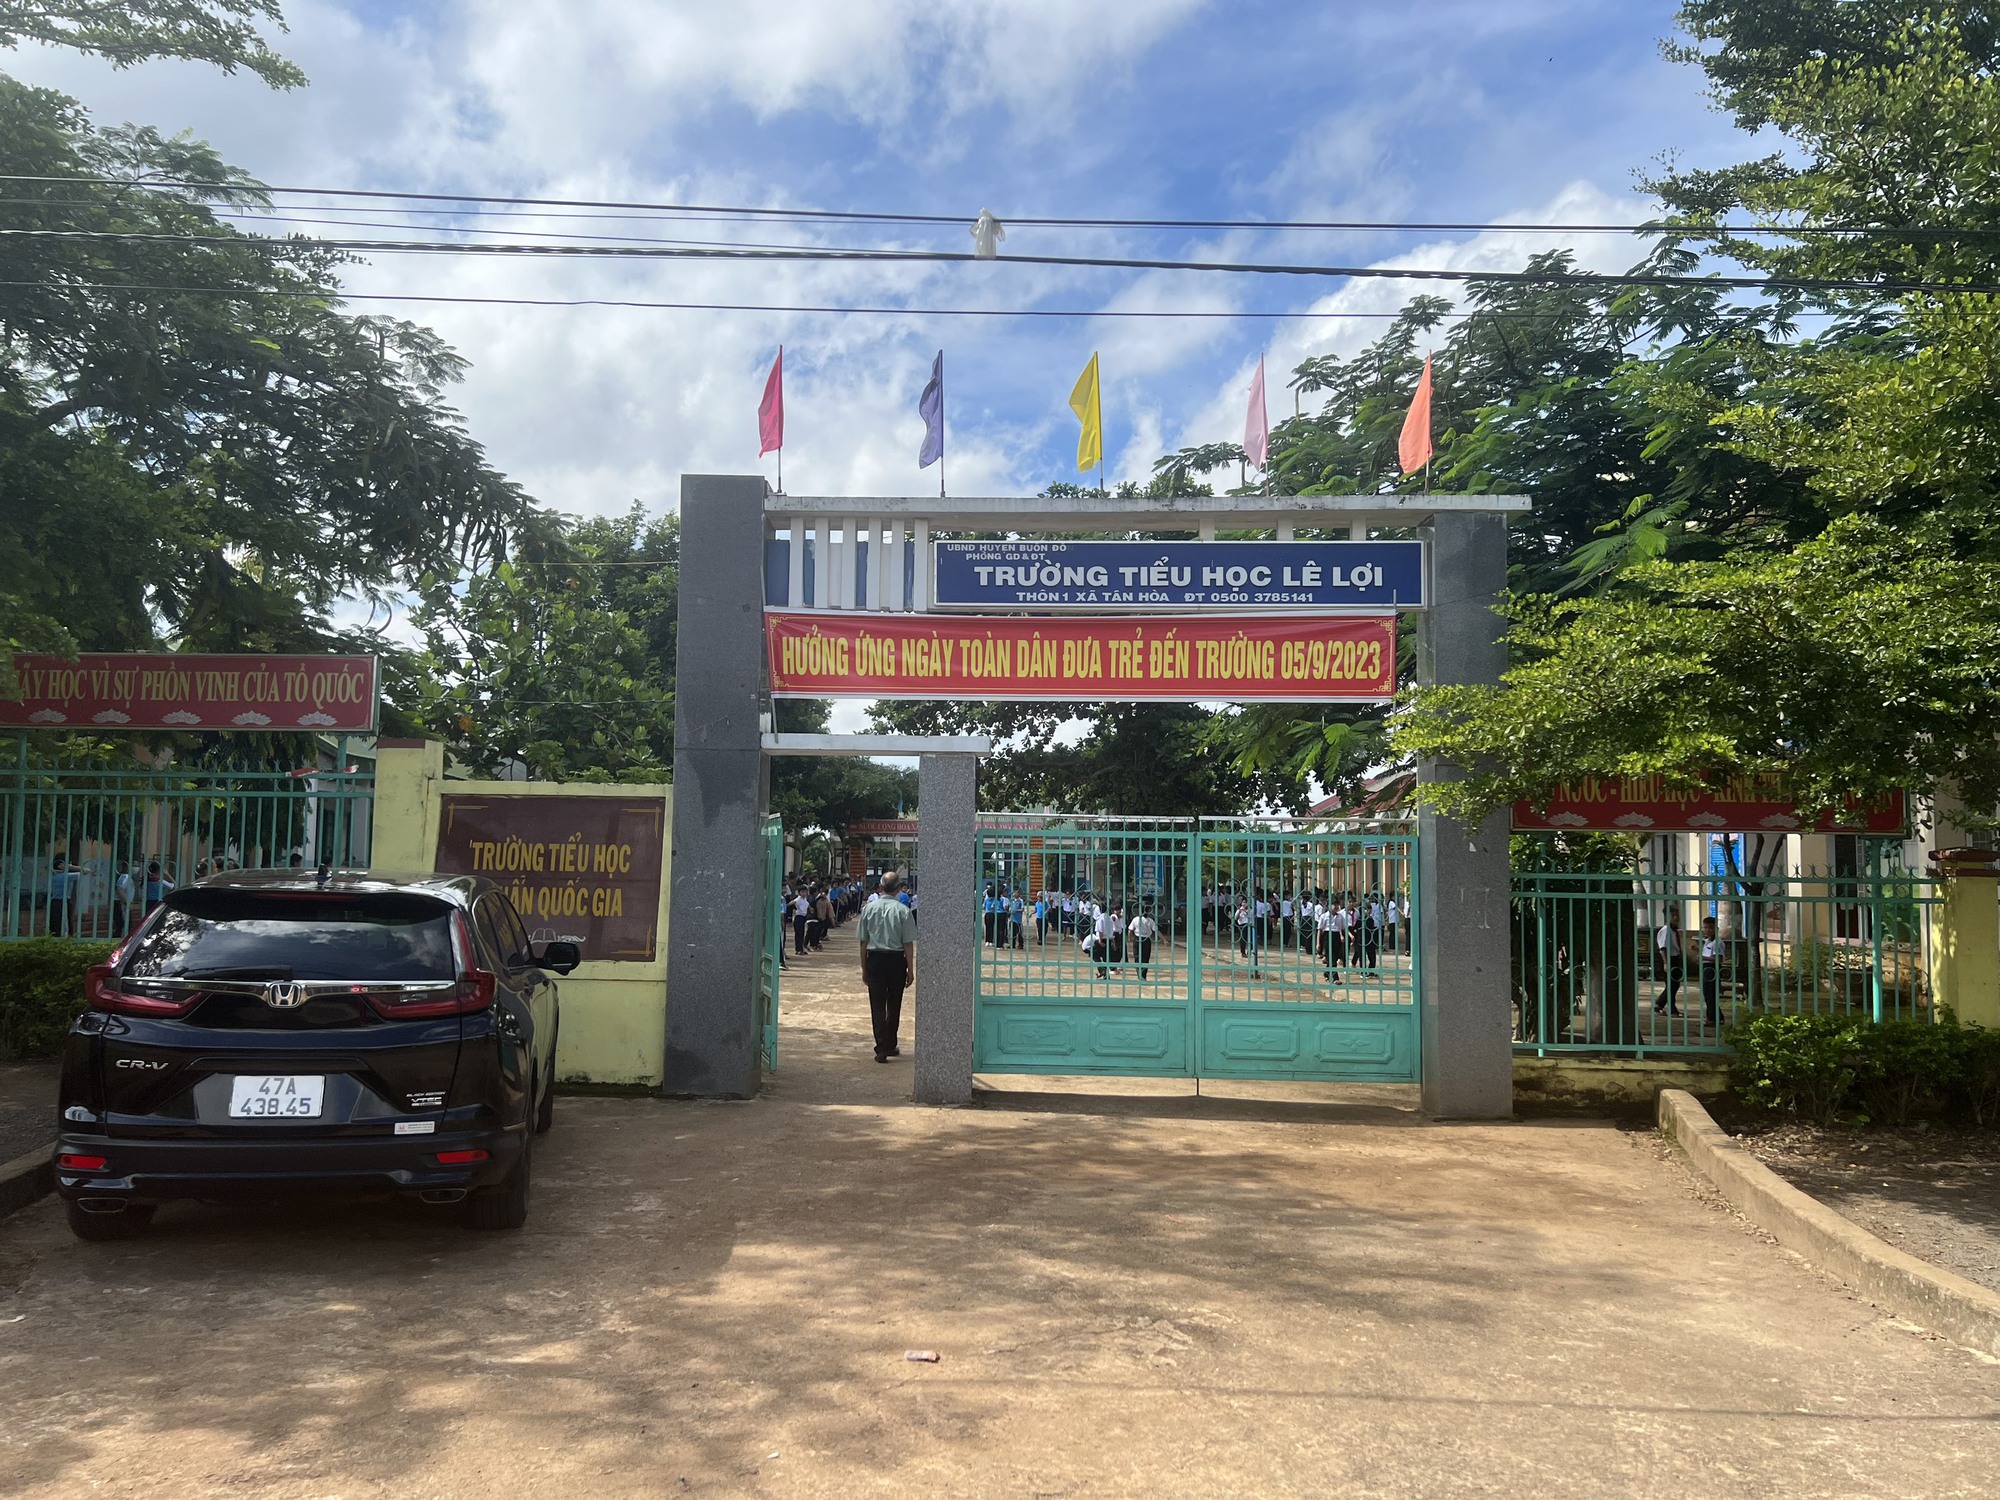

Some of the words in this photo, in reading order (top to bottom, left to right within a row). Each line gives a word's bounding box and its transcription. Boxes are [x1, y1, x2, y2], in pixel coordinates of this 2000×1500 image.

[947, 543, 976, 552] UBND
[974, 559, 1108, 587] TRƯỜNG
[1118, 556, 1192, 587] TIỂU
[1202, 566, 1272, 592] HỌC
[1283, 560, 1322, 587] LÊ
[1332, 562, 1383, 592] LỢI
[1016, 589, 1060, 602] THÔN
[1076, 589, 1098, 602] XÃ
[1102, 589, 1133, 602] TÂN
[1138, 590, 1170, 602] HÒA
[1184, 592, 1205, 602] ĐT
[1210, 592, 1249, 602] 0500
[1254, 592, 1313, 602] 3785141
[781, 624, 849, 676] HƯỞNG
[855, 630, 896, 677] ỨNG
[901, 631, 954, 677] NGÀY
[960, 631, 1011, 678] TOÀN
[1017, 632, 1057, 678] DÂN
[1063, 636, 1102, 679] ĐƯA
[1109, 627, 1143, 679] TRẺ
[1150, 628, 1190, 679] ĐẾN
[1196, 631, 1275, 679] TRƯỜNG
[1281, 641, 1381, 680] 05/9/2023
[17, 661, 46, 700] ÃY
[48, 669, 87, 708] HỌC
[91, 661, 111, 700] VÌ
[113, 665, 140, 708] SỰ
[141, 661, 191, 701] PHỒN
[195, 670, 240, 702] VINH
[243, 662, 281, 702] CỦA
[283, 663, 309, 703] TỔ
[312, 663, 364, 709] QUỐC
[473, 835, 544, 872] TRƯỜNG
[549, 832, 588, 872] TIỂU
[594, 844, 631, 878] HỌC
[538, 876, 588, 921] QUỐC
[592, 888, 623, 917] GIA
[115, 1059, 168, 1070] CR-V
[259, 1077, 296, 1095] 47A
[241, 1098, 311, 1115] 438.45
